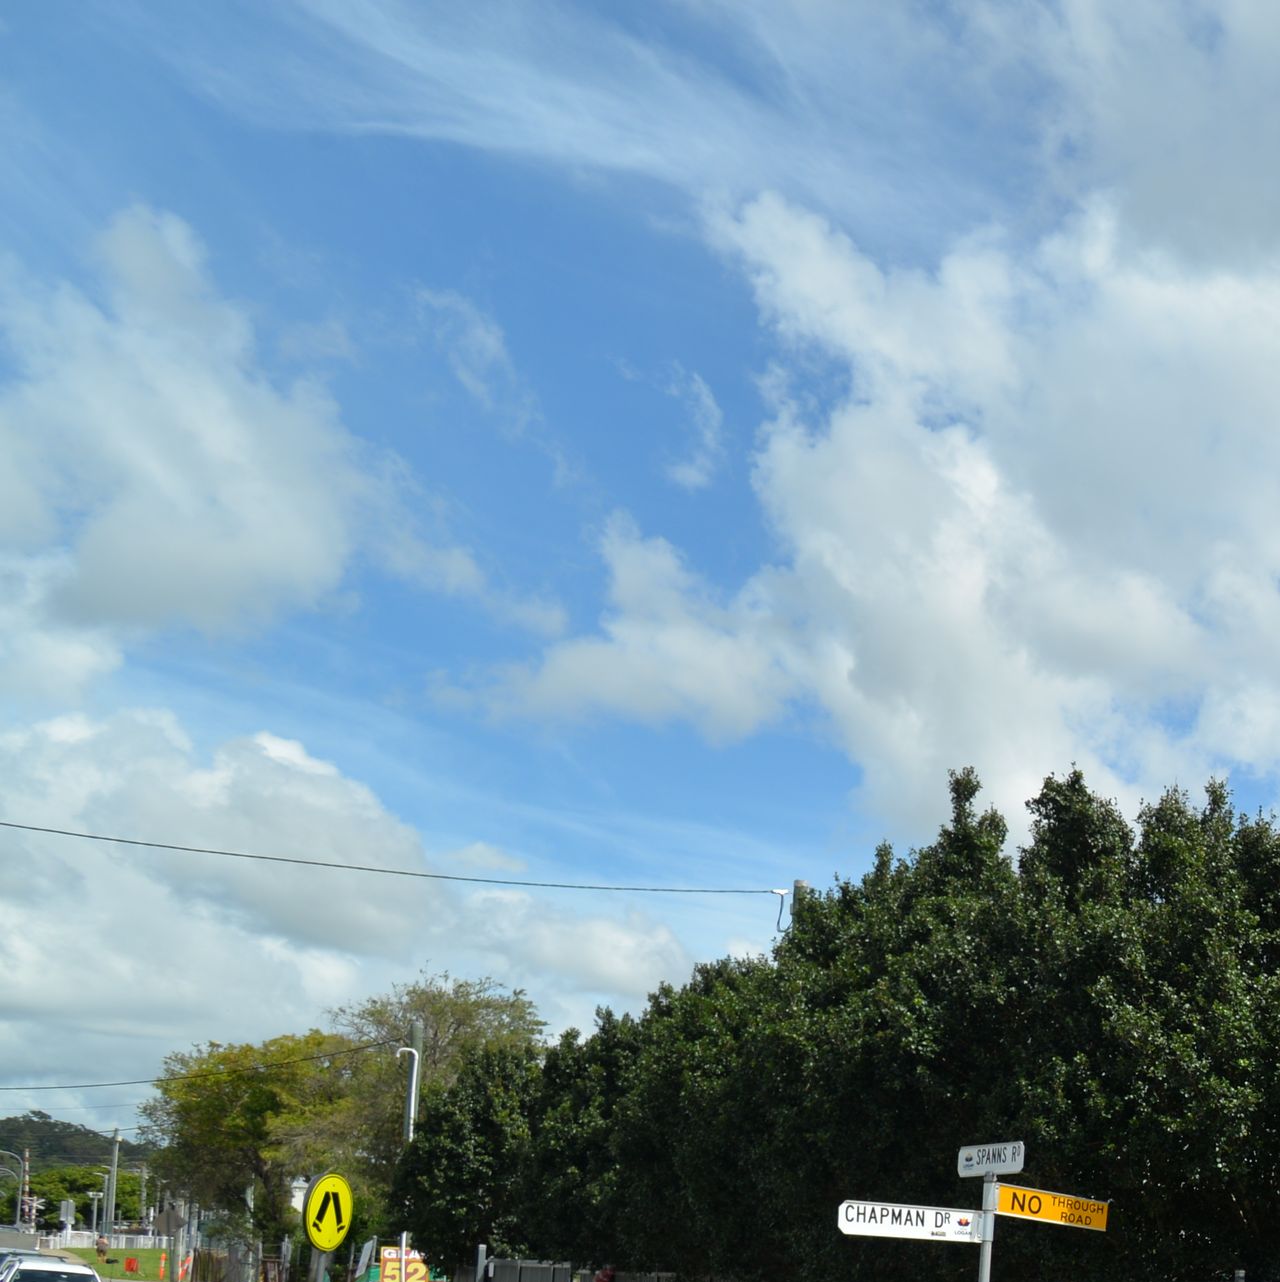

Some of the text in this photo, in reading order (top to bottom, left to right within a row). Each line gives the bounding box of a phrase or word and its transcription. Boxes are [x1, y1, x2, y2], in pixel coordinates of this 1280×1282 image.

[975, 1147, 1007, 1166] SPANNS
[1011, 1192, 1105, 1215] NO THROUGH
[845, 1204, 951, 1228] CHAPMAN DR
[1060, 1211, 1092, 1226] ROAD
